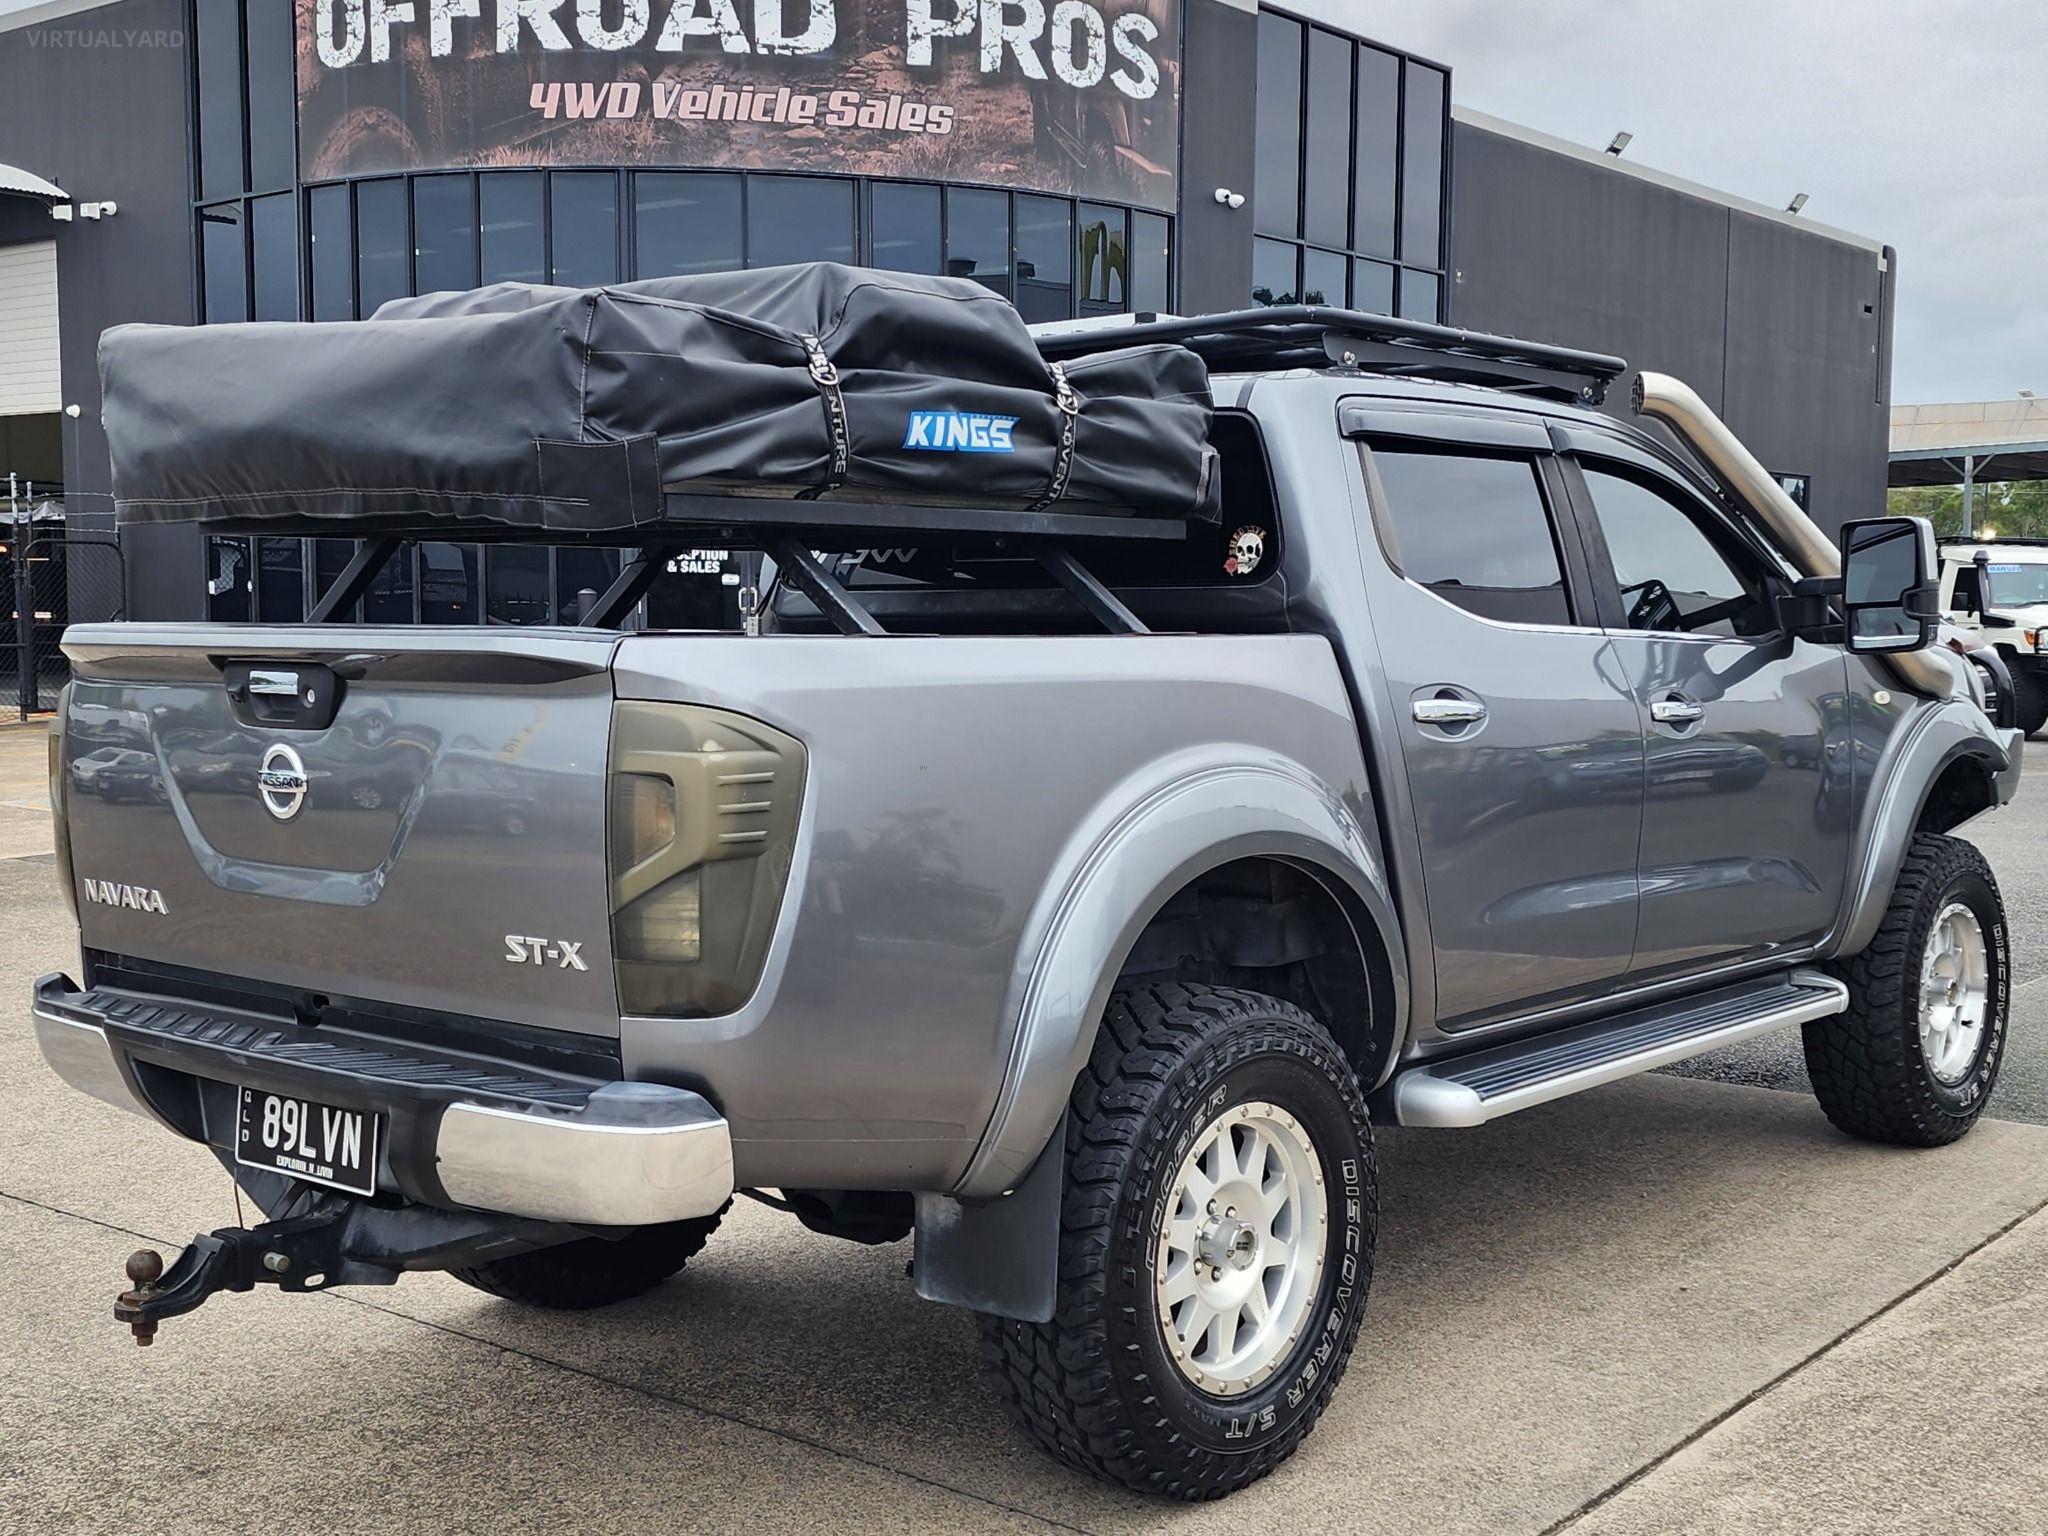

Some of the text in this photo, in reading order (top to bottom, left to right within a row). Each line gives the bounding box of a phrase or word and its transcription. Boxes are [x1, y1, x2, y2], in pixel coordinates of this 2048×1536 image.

[315, 0, 1160, 99] OFFROAD PROS
[529, 82, 954, 134] 4WD Vehicle Sales
[907, 415, 1015, 448] KINGS
[667, 560, 721, 573] & SALES
[261, 774, 304, 788] NISSAN
[84, 878, 170, 915] NAVARA
[504, 935, 589, 971] ST-X
[1145, 1084, 1227, 1271] COOPER
[1225, 1159, 1361, 1439] DISCOVERER S/T
